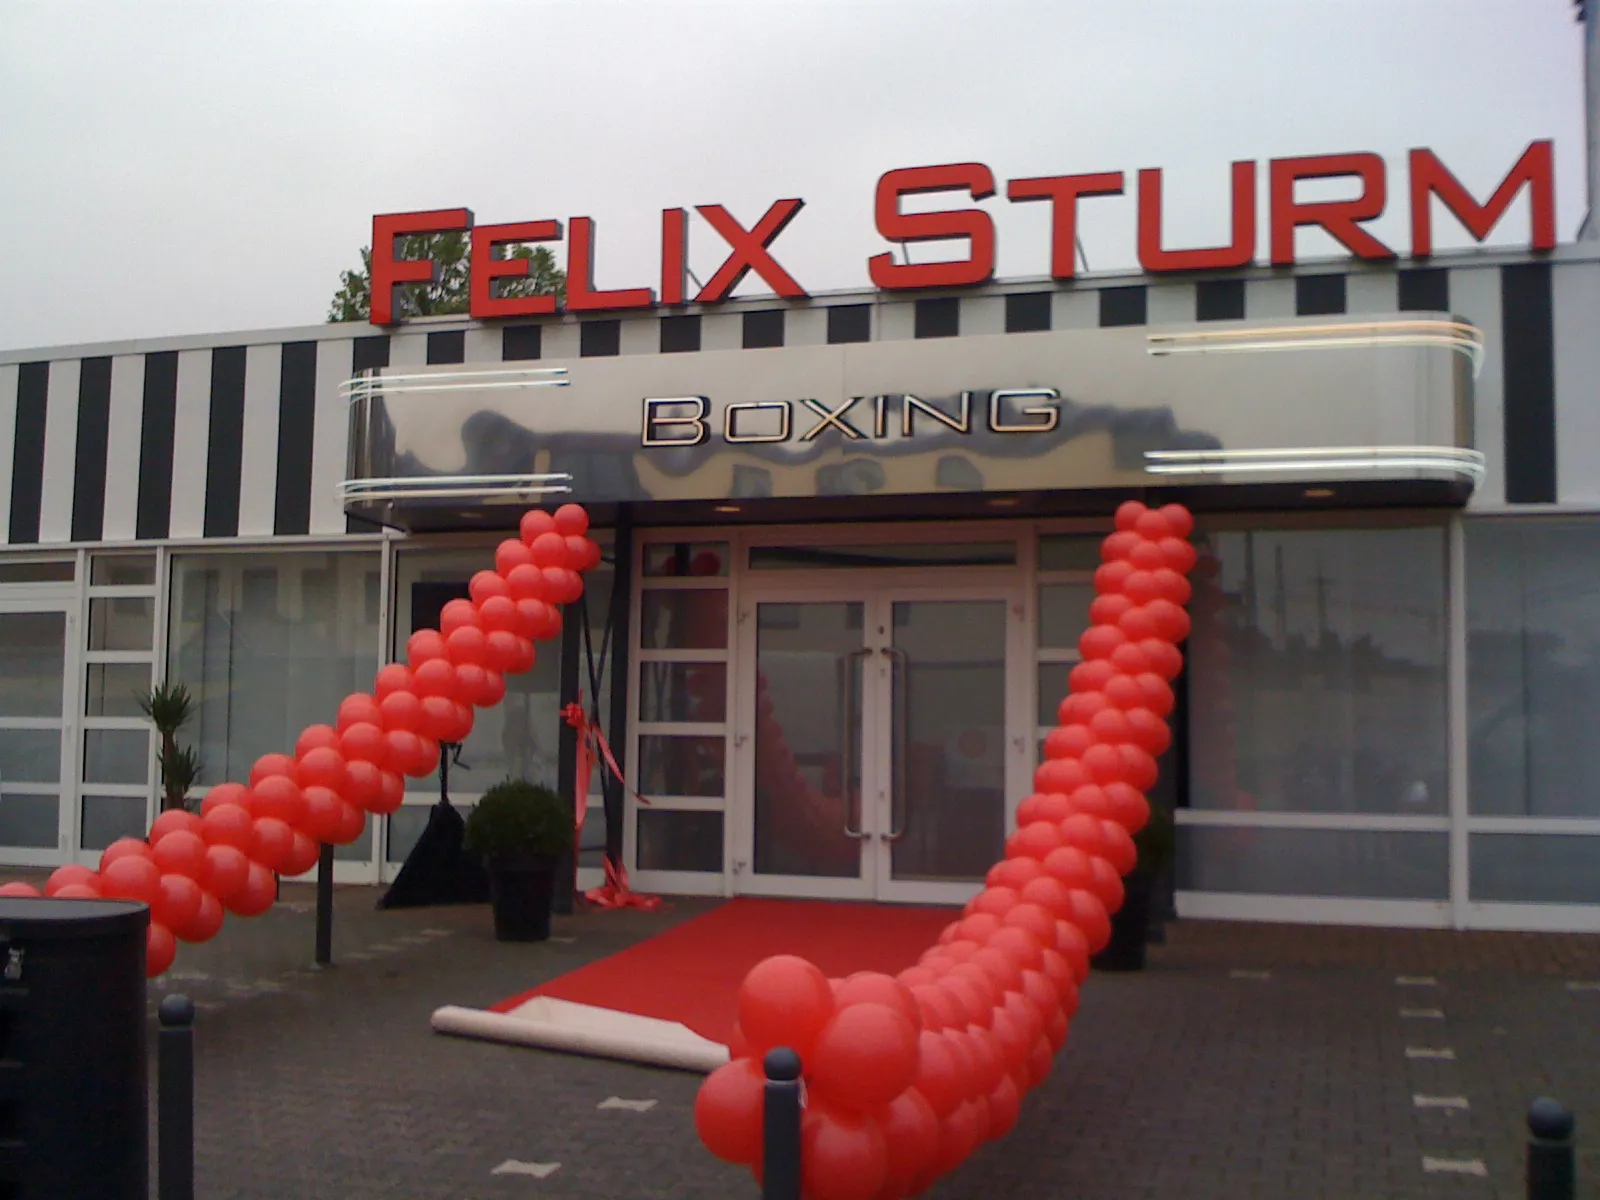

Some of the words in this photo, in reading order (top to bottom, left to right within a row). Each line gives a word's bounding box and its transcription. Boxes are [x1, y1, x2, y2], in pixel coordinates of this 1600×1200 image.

[370, 198, 809, 325] FELIX
[868, 139, 1555, 289] STURM
[642, 388, 1061, 447] BOXING
